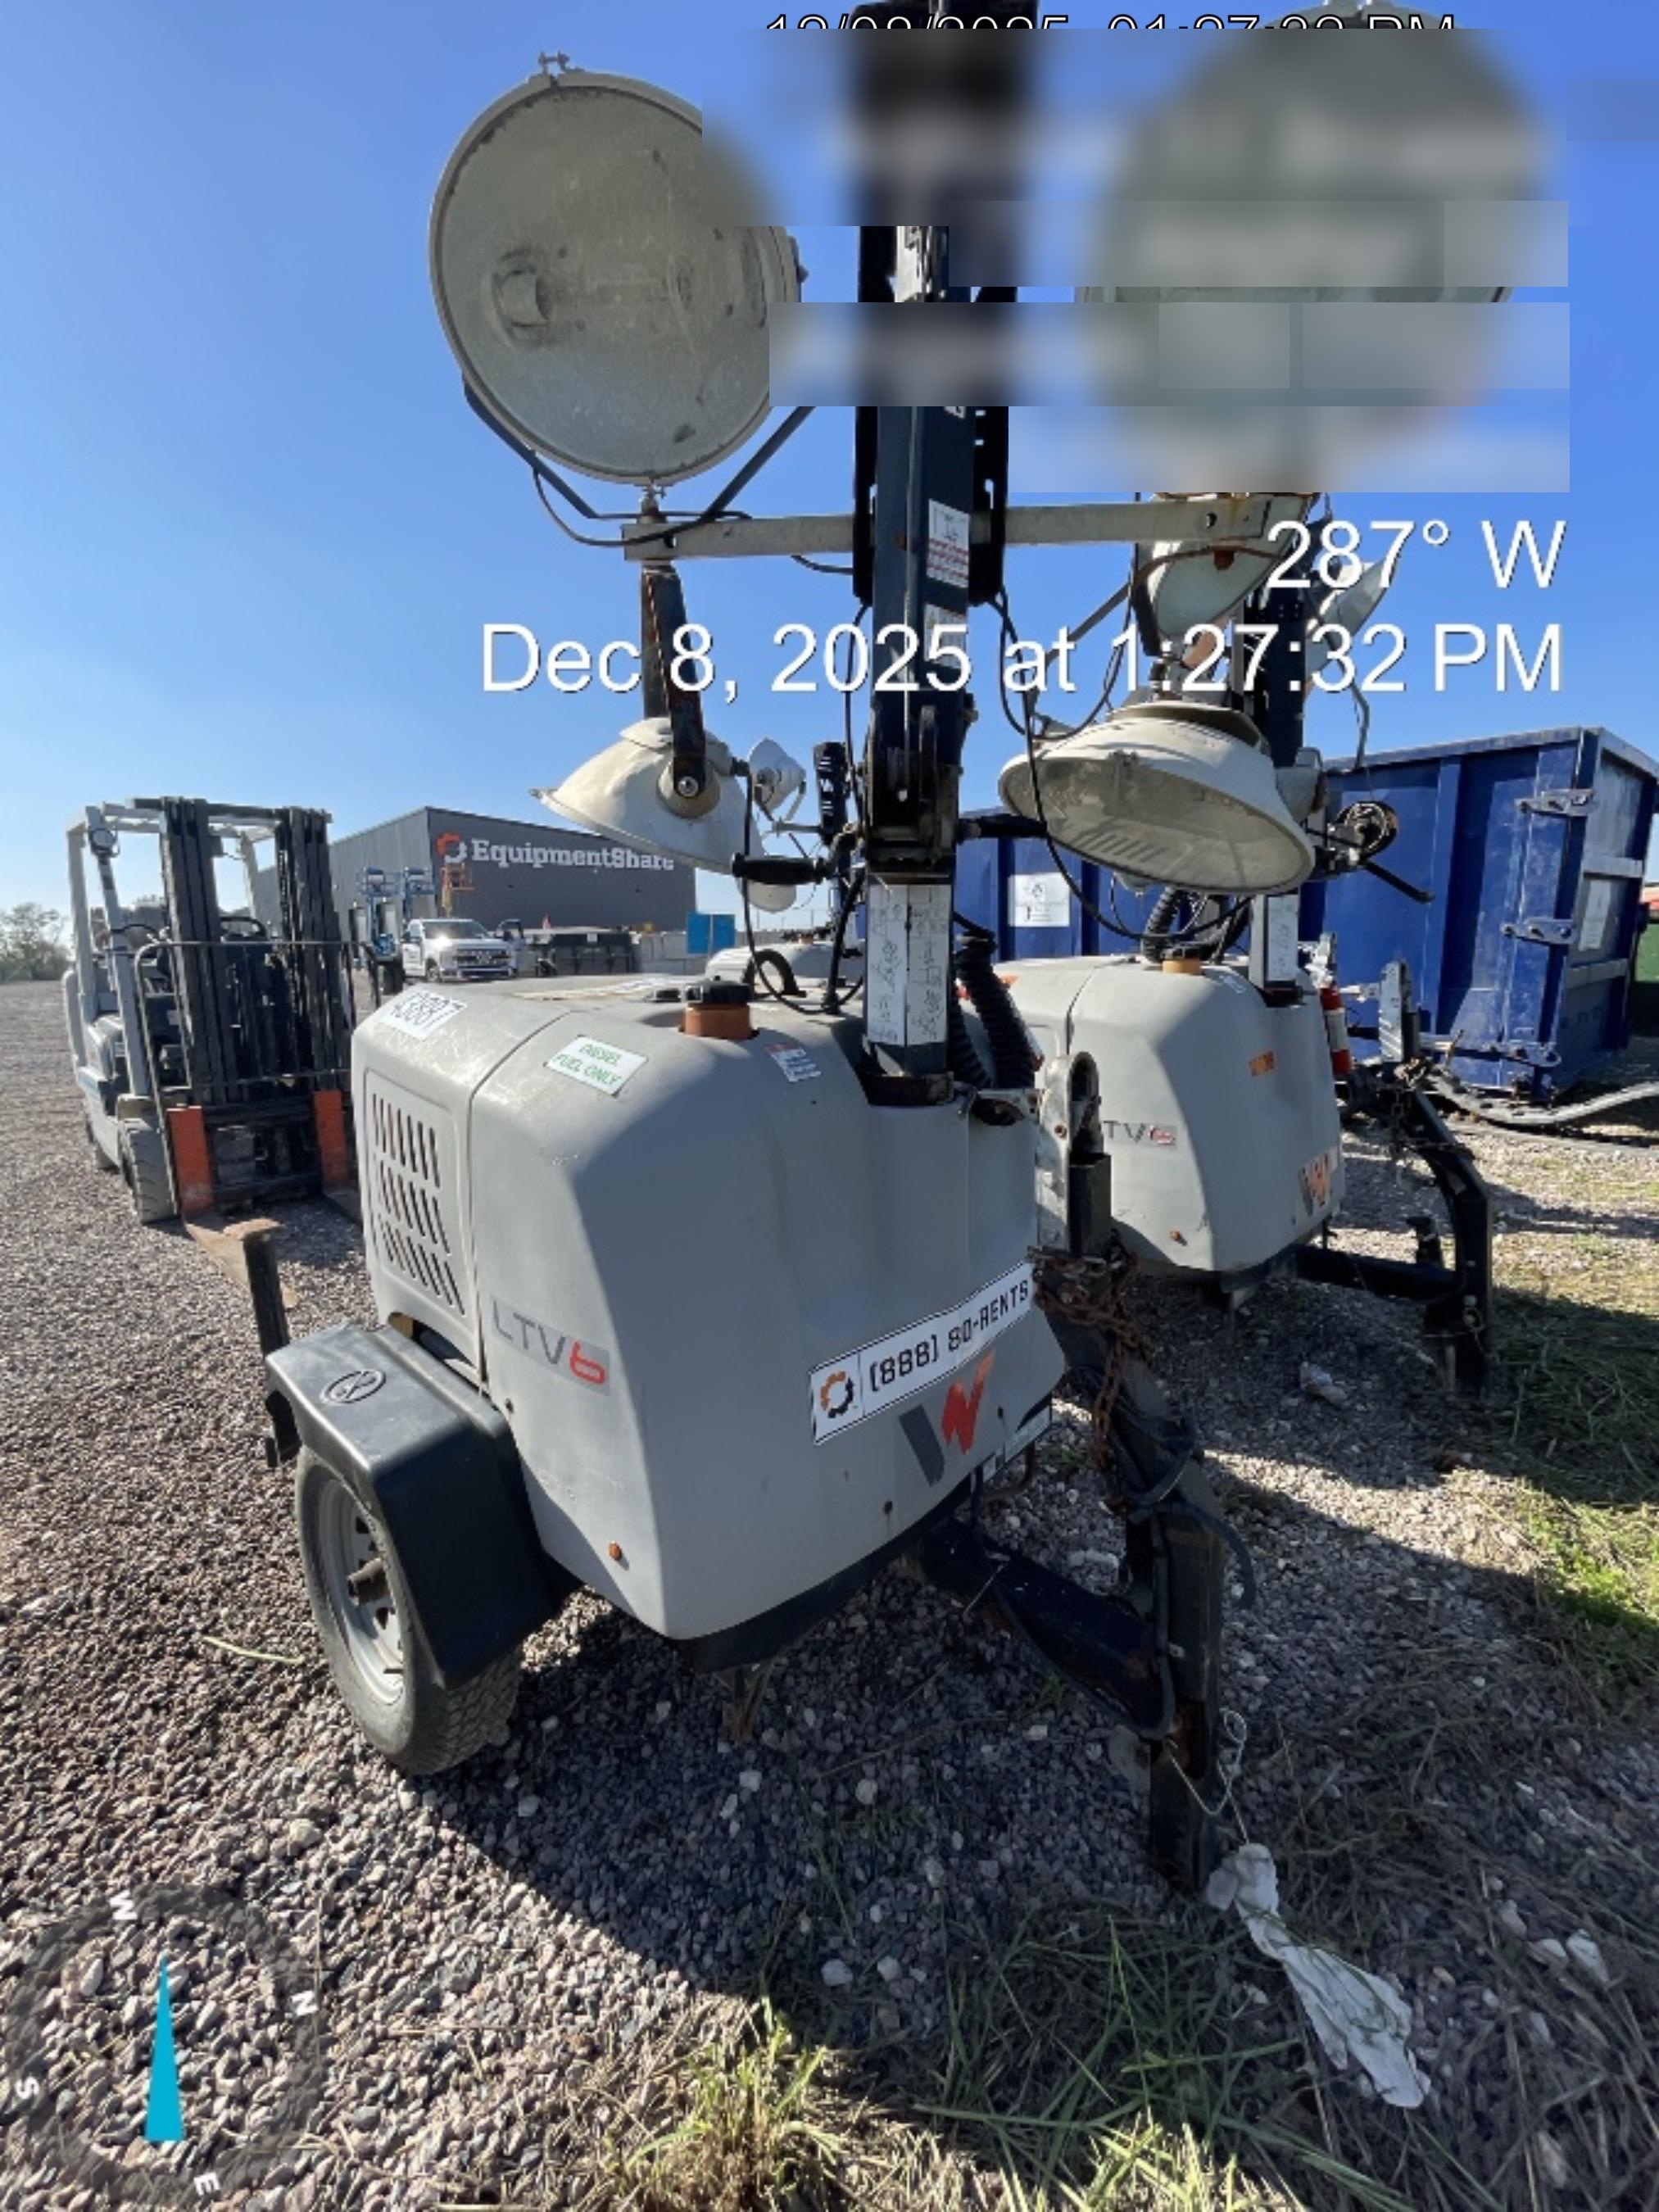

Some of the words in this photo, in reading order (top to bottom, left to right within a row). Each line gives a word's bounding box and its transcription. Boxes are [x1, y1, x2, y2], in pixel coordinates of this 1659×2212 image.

[471, 838, 674, 871] EquipmentShare
[552, 1054, 583, 1072] FUEL
[583, 1065, 623, 1087] ONLY
[493, 1300, 606, 1385] LTV6
[948, 1280, 1029, 1353] 80-RENTS
